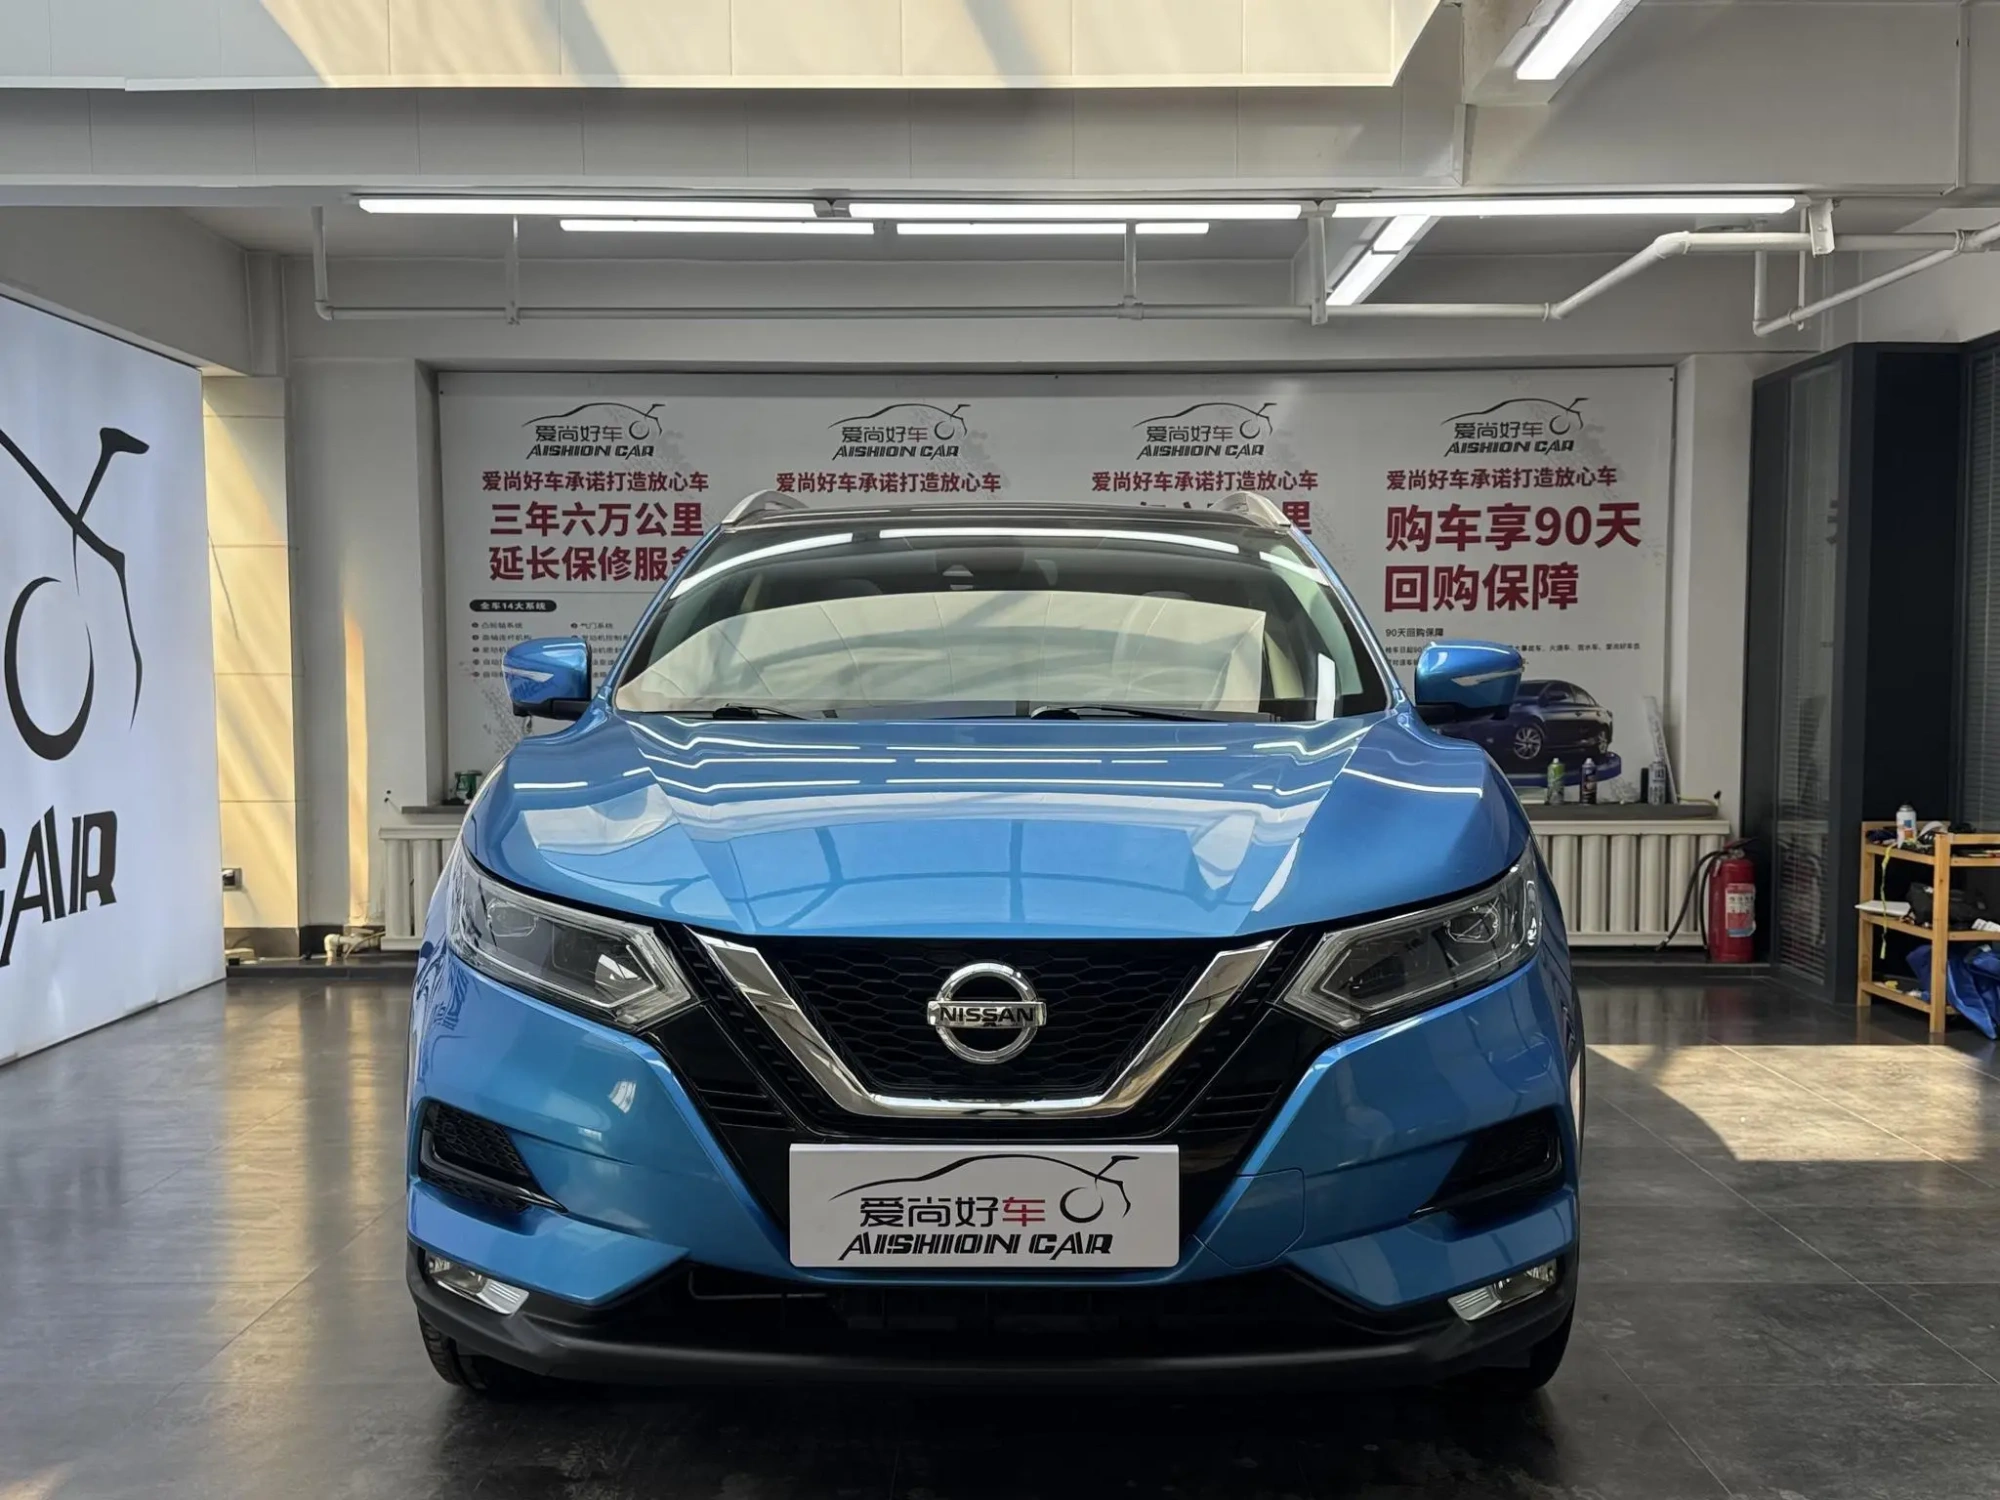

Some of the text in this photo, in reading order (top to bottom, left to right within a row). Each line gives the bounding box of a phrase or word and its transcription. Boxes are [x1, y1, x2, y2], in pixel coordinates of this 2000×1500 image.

[535, 425, 623, 443] 爱尚好车
[842, 426, 928, 443] 爱尚好车
[1146, 425, 1234, 443] 爱尚好车
[1454, 421, 1543, 439] 爱尚好车
[526, 444, 655, 460] AISHION CAR
[832, 444, 959, 460] AISHION CAR
[1136, 443, 1265, 460] AISHION CAR
[1444, 439, 1575, 457] AISHION CAR
[482, 471, 709, 492] 爱尚好车承诺打造放心车
[776, 472, 1001, 493] 爱尚好车承诺打造放心车
[1091, 470, 1319, 492] 爱尚好车承诺打造放心车
[1386, 466, 1618, 490] 爱尚好车承诺打造放心车
[490, 501, 704, 537] 三年六万公里
[1385, 502, 1642, 552] 购车享90天
[1385, 562, 1579, 612] 回购保障
[0, 805, 118, 968] AR
[940, 1007, 1034, 1022] NISSAN
[859, 1196, 1046, 1228] 爱尚好车
[838, 1231, 1113, 1261] AISHION CAR
